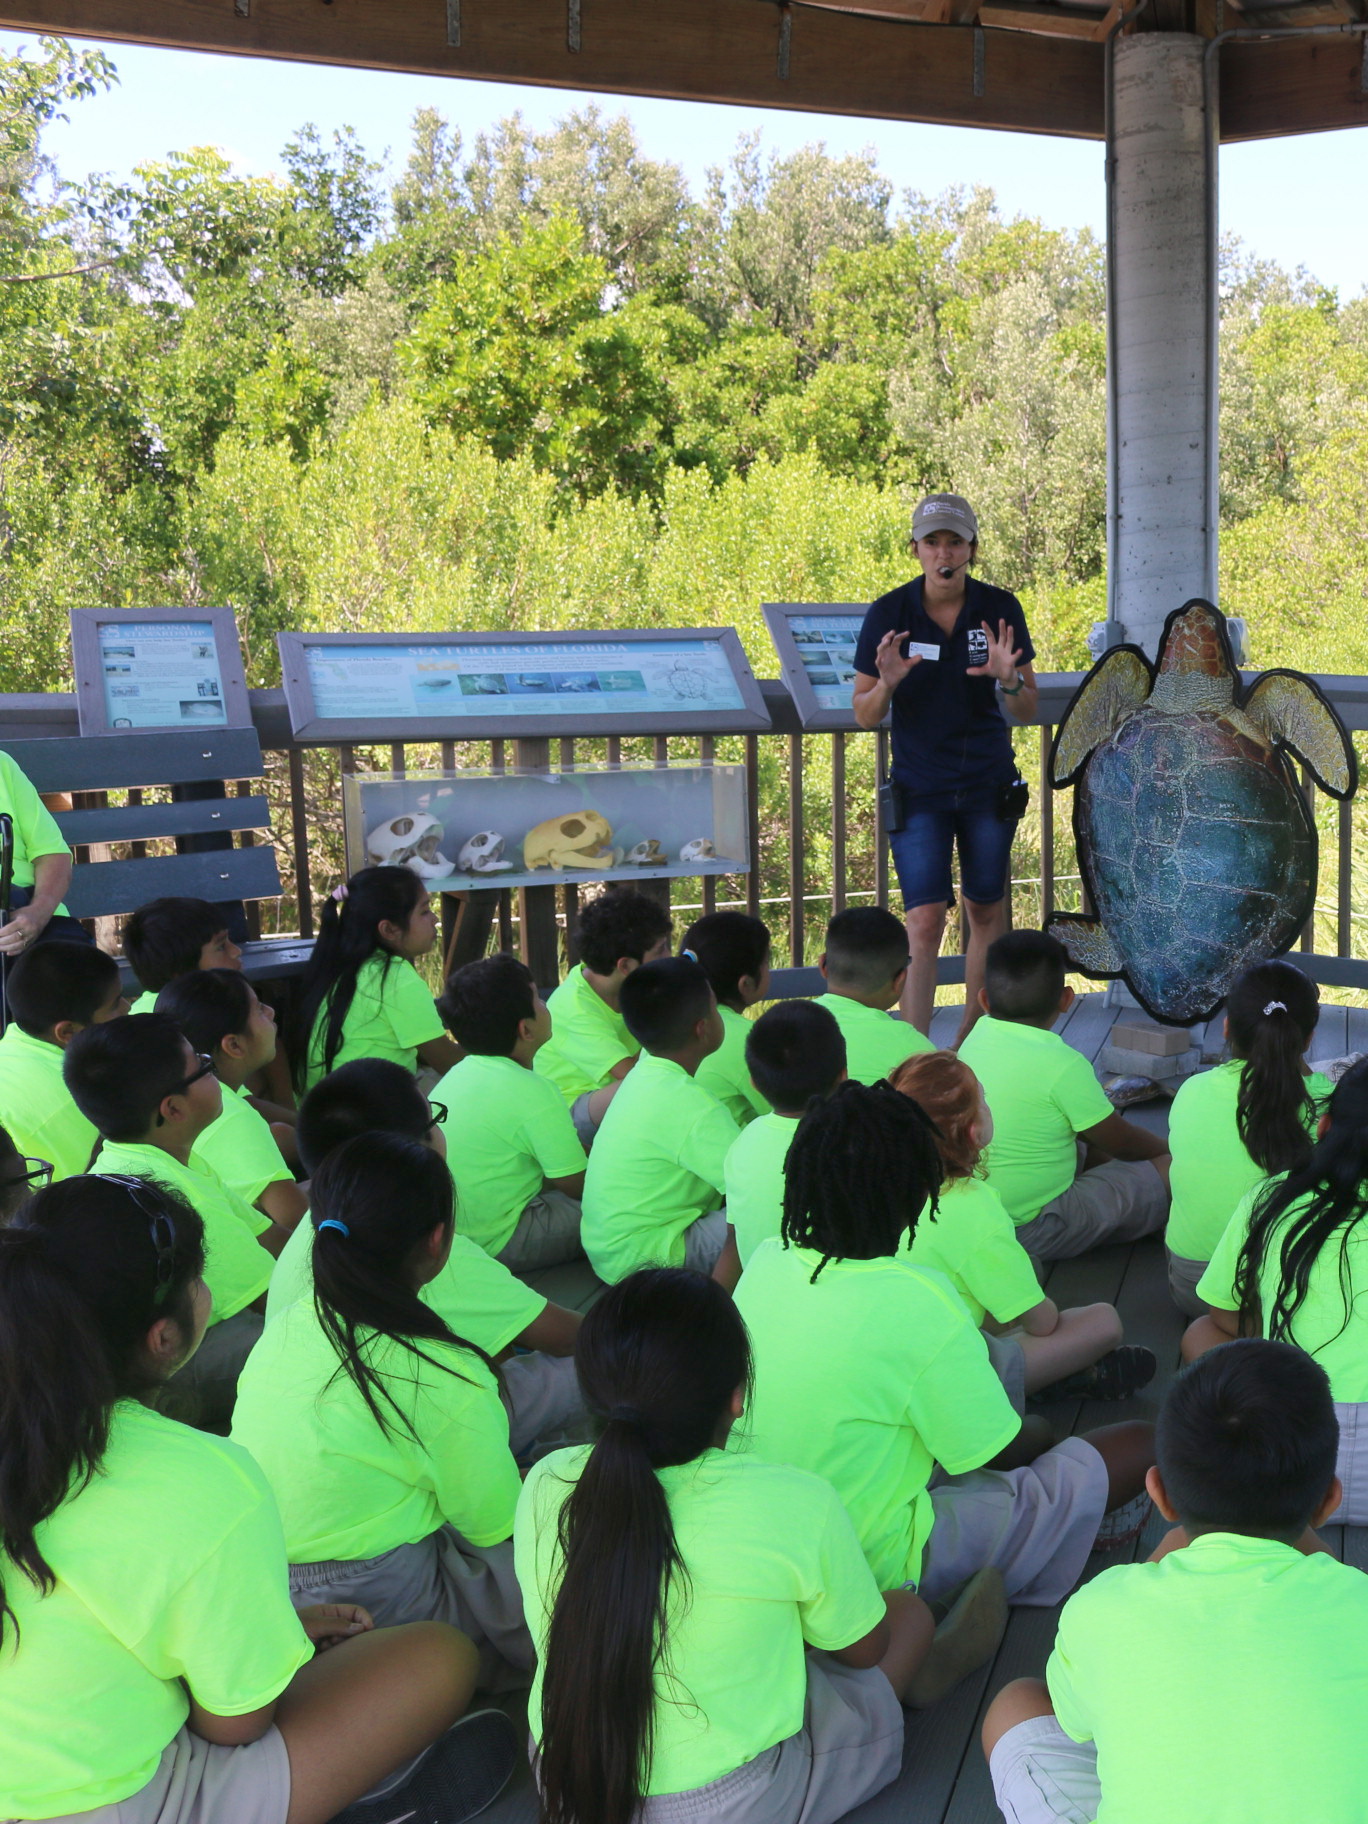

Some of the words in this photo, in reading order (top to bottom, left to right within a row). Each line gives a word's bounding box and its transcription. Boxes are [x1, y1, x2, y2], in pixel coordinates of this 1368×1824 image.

[407, 646, 440, 656] SEA
[445, 645, 521, 656] TURTLES
[525, 645, 546, 655] OF
[553, 643, 628, 654] FLORIDA
